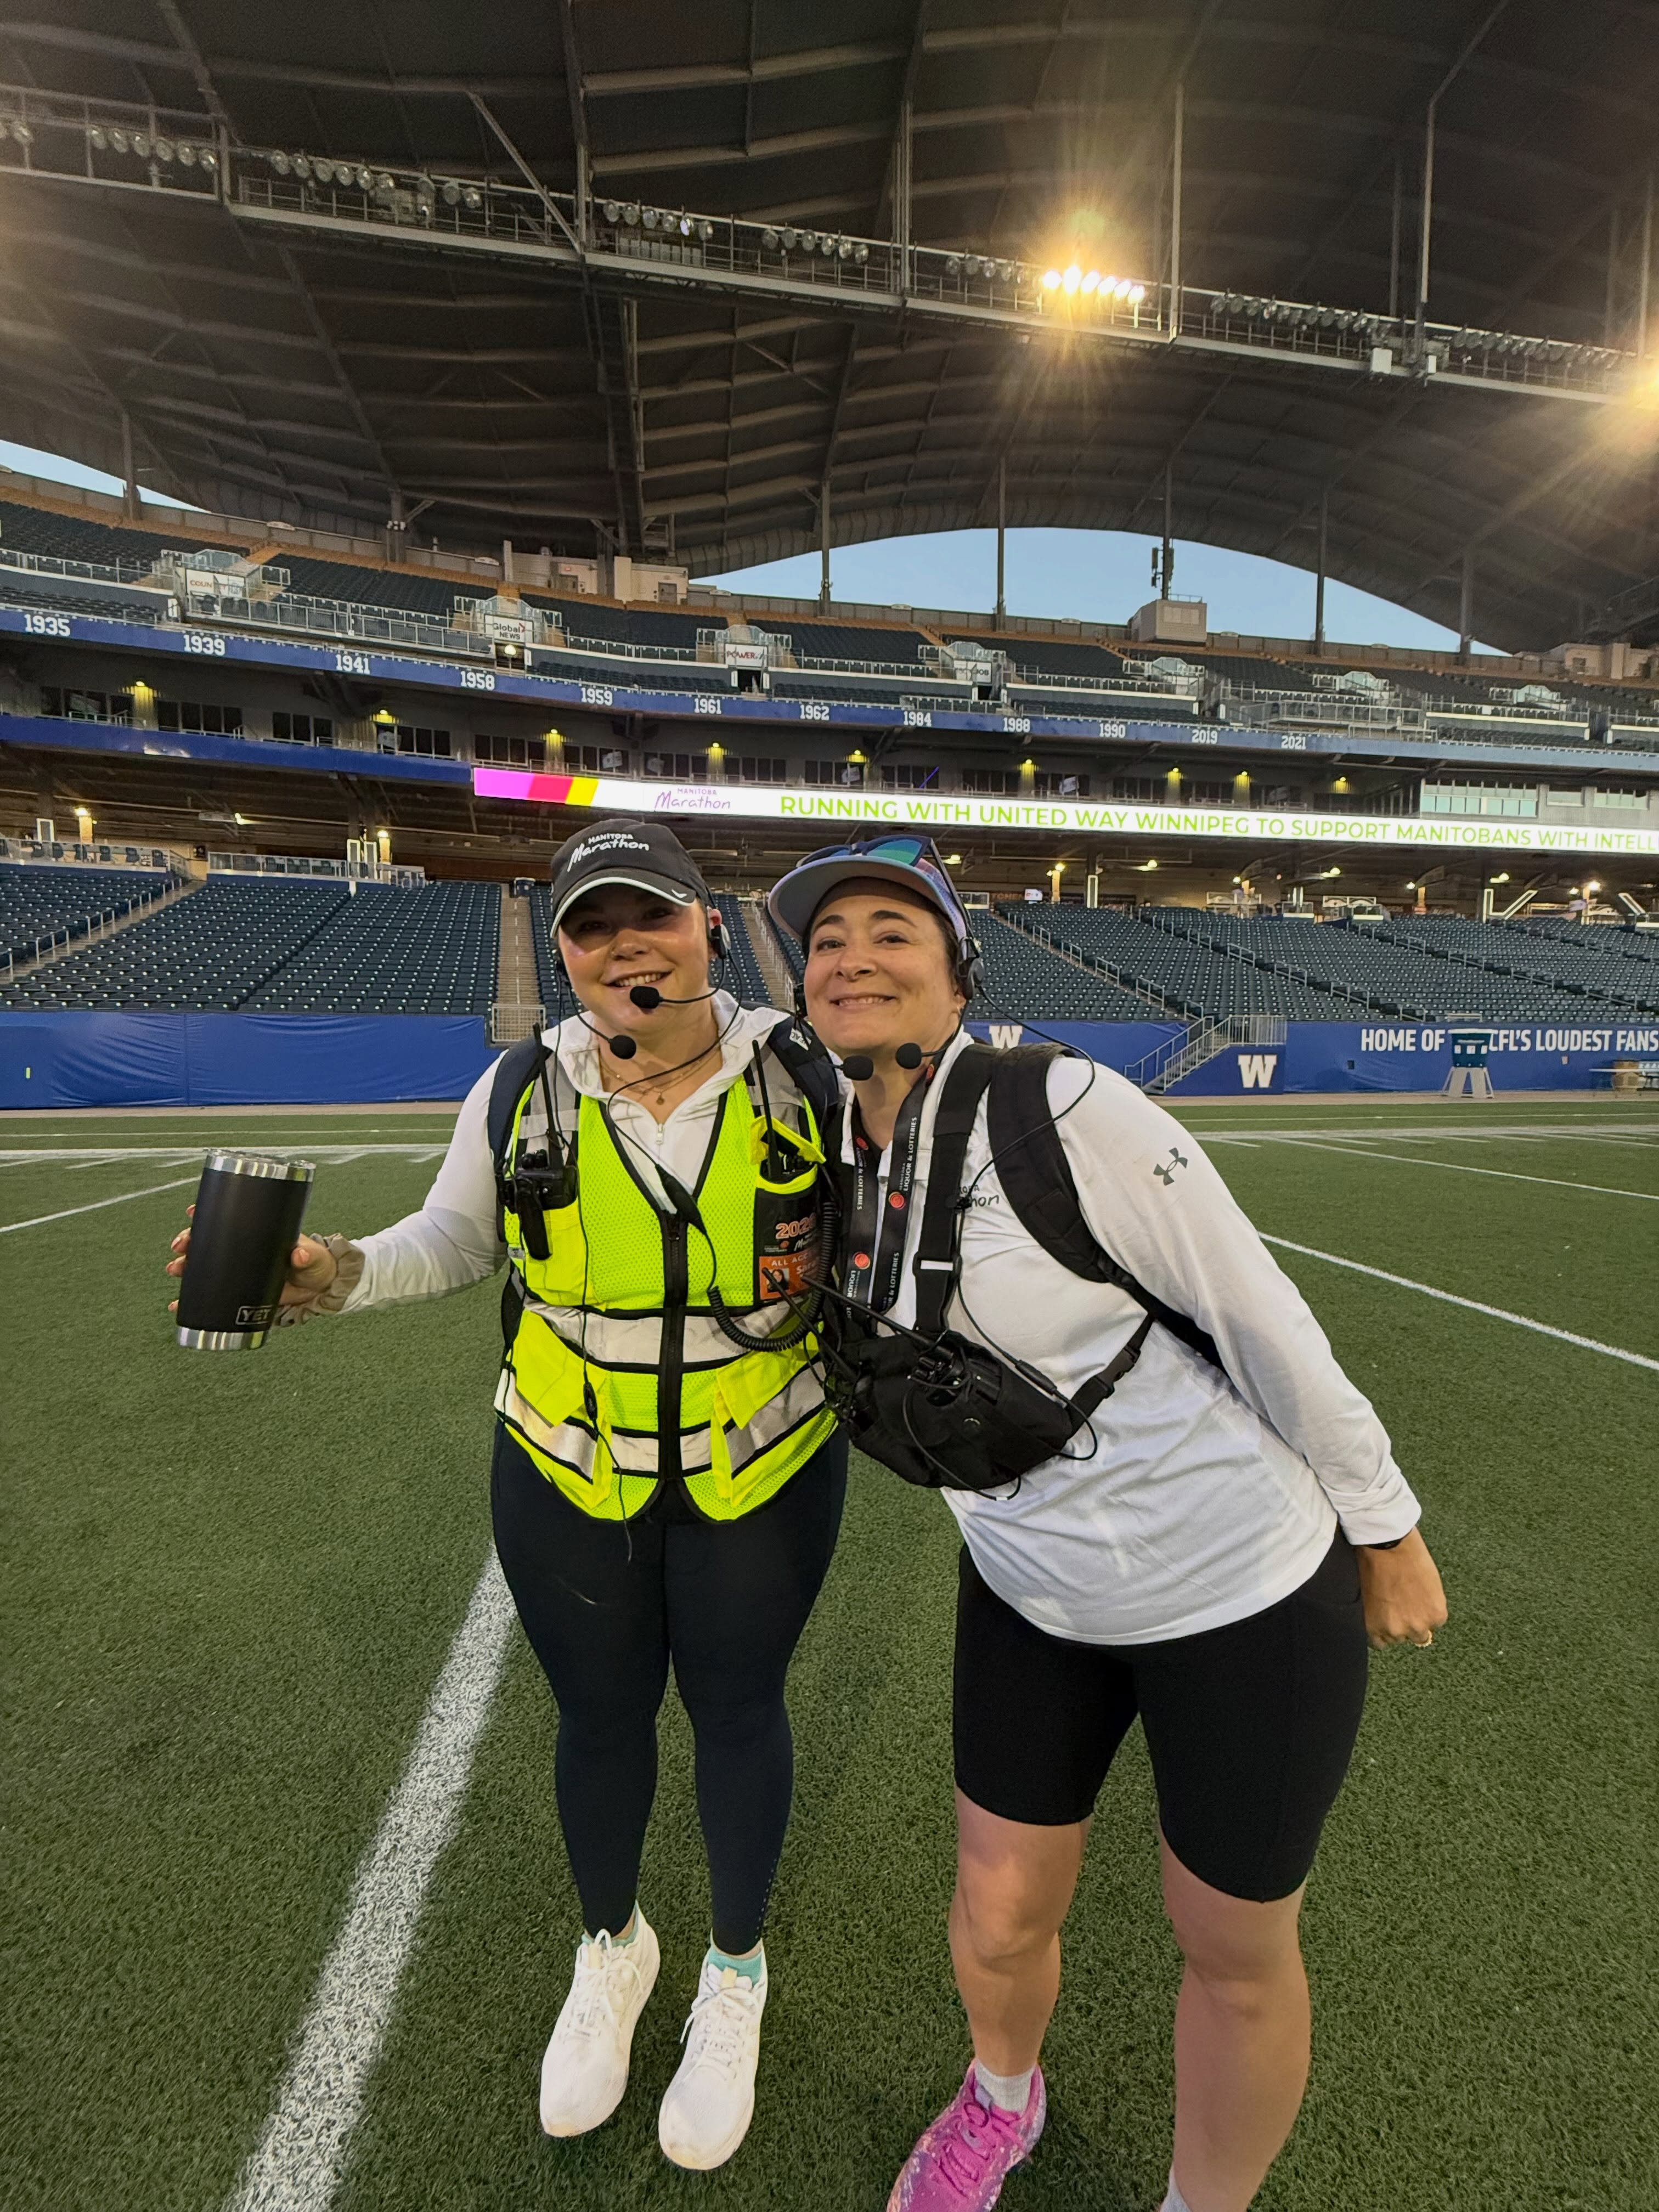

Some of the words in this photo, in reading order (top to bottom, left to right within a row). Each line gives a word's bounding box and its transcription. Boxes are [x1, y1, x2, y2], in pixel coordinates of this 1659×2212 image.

[25, 613, 71, 637] 1935
[493, 623, 521, 633] Global
[184, 634, 225, 656] 1939
[500, 631, 521, 640] NEWS
[335, 654, 370, 675] 1941
[726, 651, 755, 659] POWER
[460, 670, 495, 691] 1958
[581, 687, 613, 706] 1959
[694, 698, 722, 715] 1961
[800, 704, 830, 721] 1962
[903, 711, 932, 727] 1984
[1003, 717, 1031, 733] 1988
[1099, 723, 1126, 739] 1990
[1191, 728, 1218, 744] 2019
[1280, 734, 1307, 751] 2021
[654, 790, 731, 809] Marathon
[780, 795, 898, 819] RUNNING
[906, 802, 971, 821] WITH
[979, 806, 1068, 826] UNITED
[1075, 810, 1127, 828] WAY
[1135, 812, 1249, 834] WINNIPEG
[1257, 817, 1284, 836] TO
[1291, 820, 1390, 839] SUPPORT
[1396, 825, 1531, 845] MANITOBANS
[1538, 831, 1588, 848] WITH
[588, 833, 634, 844] MANITOBA
[567, 839, 650, 872] Marathon
[989, 1025, 1023, 1048] W
[1361, 1029, 1416, 1051] HOME
[1421, 1029, 1446, 1052] OF
[1536, 1029, 1613, 1052] LOUDEST
[1616, 1030, 1659, 1052] FANS
[1238, 1054, 1277, 1088] W
[908, 1117, 917, 1150] LOTTERIES
[907, 1150, 913, 1161] &
[903, 1162, 912, 1191] LIQUOR
[890, 1252, 900, 1288] LOTTERIES
[847, 1270, 856, 1298] LIQUOR
